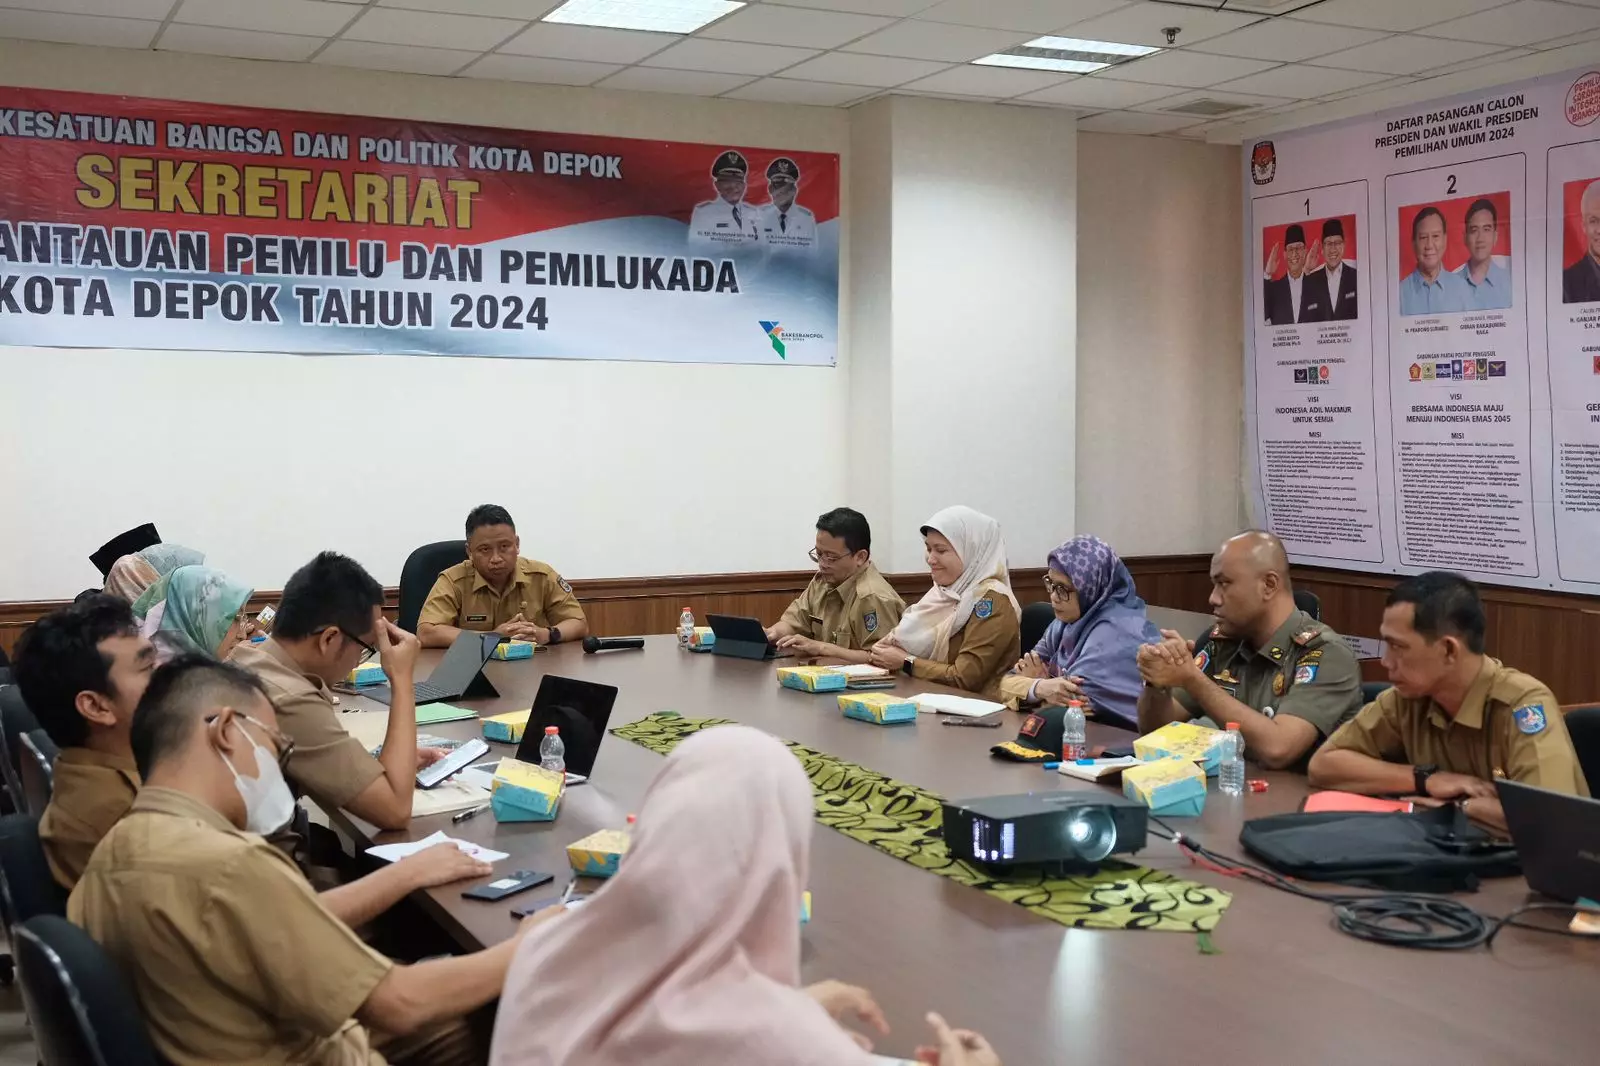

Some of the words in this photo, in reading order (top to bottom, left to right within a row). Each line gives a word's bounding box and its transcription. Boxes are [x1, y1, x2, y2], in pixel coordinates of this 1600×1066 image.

[1375, 131, 1420, 148] PRESIDEN
[1423, 125, 1446, 139] DAN
[1448, 118, 1482, 134] WAKIL
[1485, 107, 1539, 128] PRESIDEN
[1386, 115, 1424, 132] DAFTAR
[1426, 103, 1484, 124] PASANGAN
[1487, 94, 1524, 112] CALON
[0, 108, 155, 146] KESATUAN
[167, 121, 283, 156] BANGSA
[293, 131, 348, 160] DAN
[359, 137, 458, 168] POLITIK
[468, 145, 534, 174] KOTA
[544, 151, 623, 180] DEPOK
[1395, 139, 1448, 159] PEMILIHAN
[1451, 132, 1486, 148] UMUM
[1489, 126, 1514, 142] 2024
[75, 153, 481, 229] SEKRETARIAT
[1446, 174, 1457, 195] 2
[1304, 198, 1310, 216] 1
[226, 235, 385, 279] PEMILU
[402, 245, 482, 283] DAN
[501, 254, 740, 294] PEMILUKADA
[0, 274, 115, 317] KOTA
[133, 281, 281, 323] DEPOK
[296, 286, 432, 327] TAHUN
[450, 293, 549, 331] 2024
[1406, 415, 1432, 423] MENUJU
[1434, 415, 1470, 423] INDONESIA
[1445, 404, 1481, 412] INDONESIA
[1483, 404, 1504, 412] MAJU
